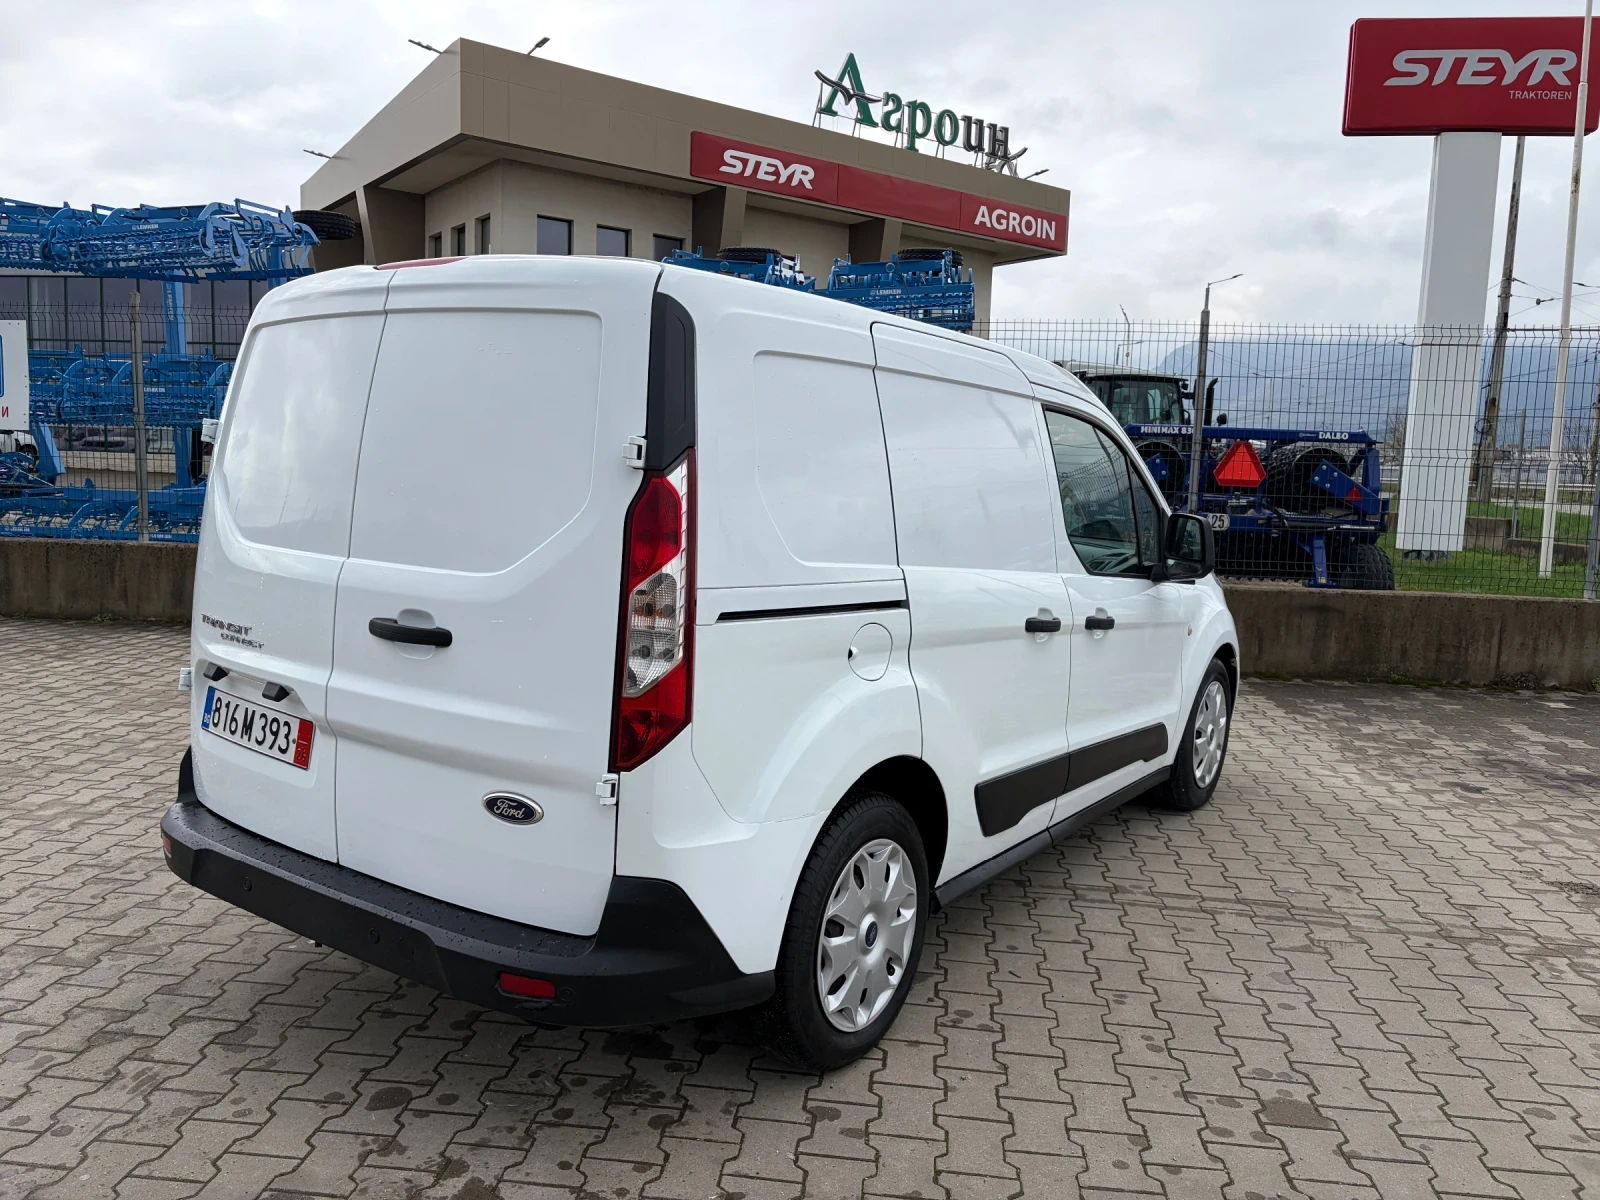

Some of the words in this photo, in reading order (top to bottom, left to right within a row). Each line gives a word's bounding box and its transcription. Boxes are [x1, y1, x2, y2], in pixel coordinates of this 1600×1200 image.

[1383, 48, 1577, 86] STEYR
[1508, 90, 1572, 100] TRAKTOREN
[719, 149, 815, 190] STEYR
[974, 205, 1056, 241] AGROIN
[1140, 426, 1179, 434] MINIMAX
[1318, 431, 1349, 440] DALBO
[1211, 514, 1225, 529] 25
[201, 614, 252, 636] TRANSIT
[493, 798, 525, 819] Ford
